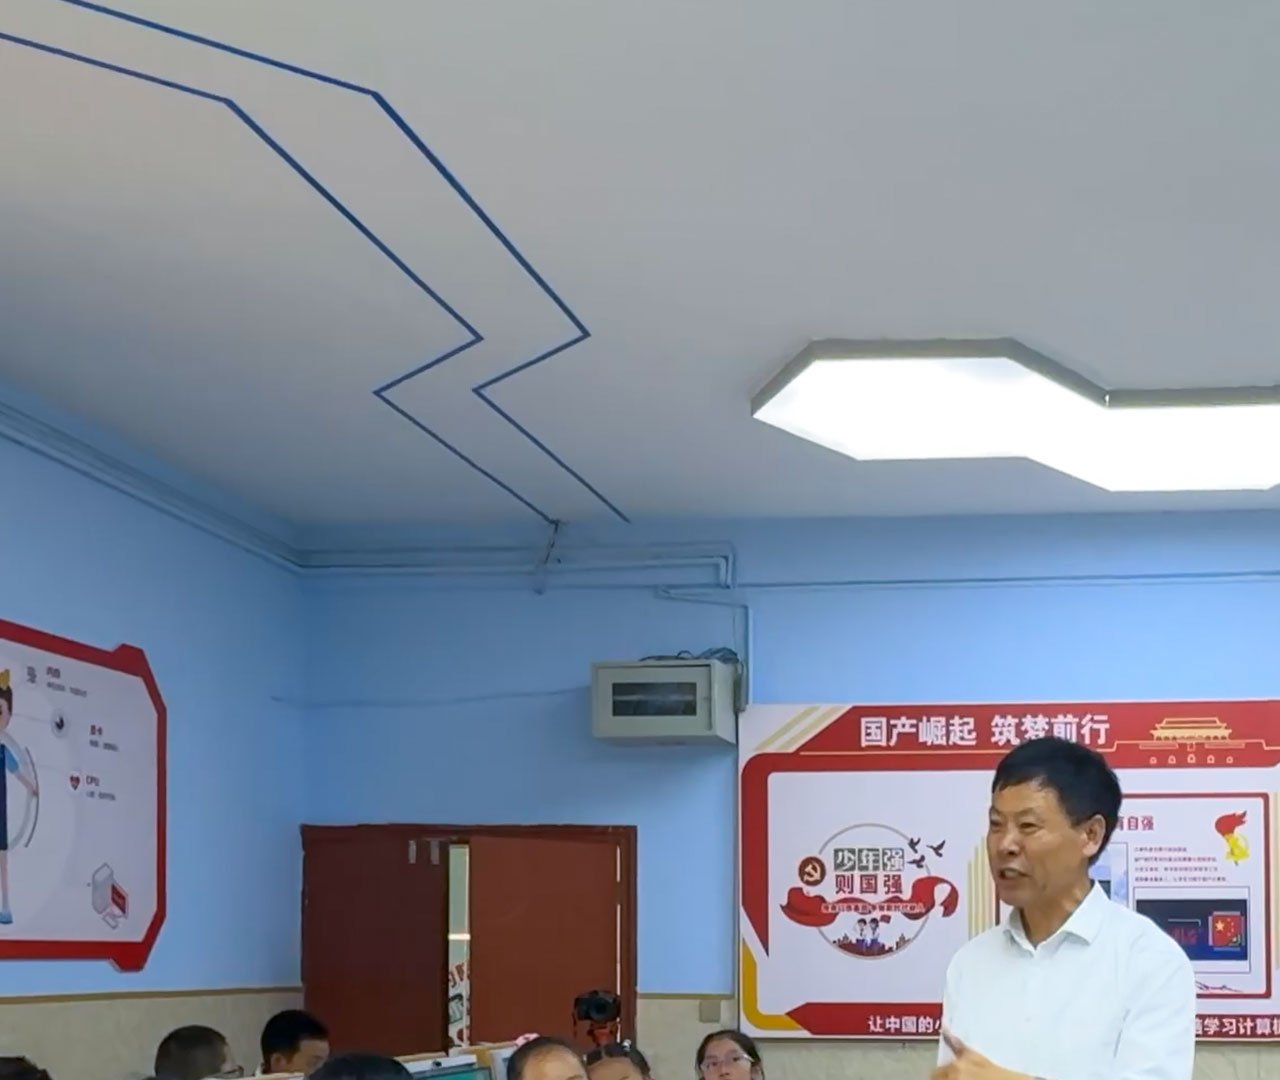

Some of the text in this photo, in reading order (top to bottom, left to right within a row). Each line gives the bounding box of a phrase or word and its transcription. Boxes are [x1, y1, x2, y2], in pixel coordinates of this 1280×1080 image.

[860, 715, 977, 747] 国产崛起
[834, 848, 905, 872] 少年强
[835, 874, 903, 894] 则国强
